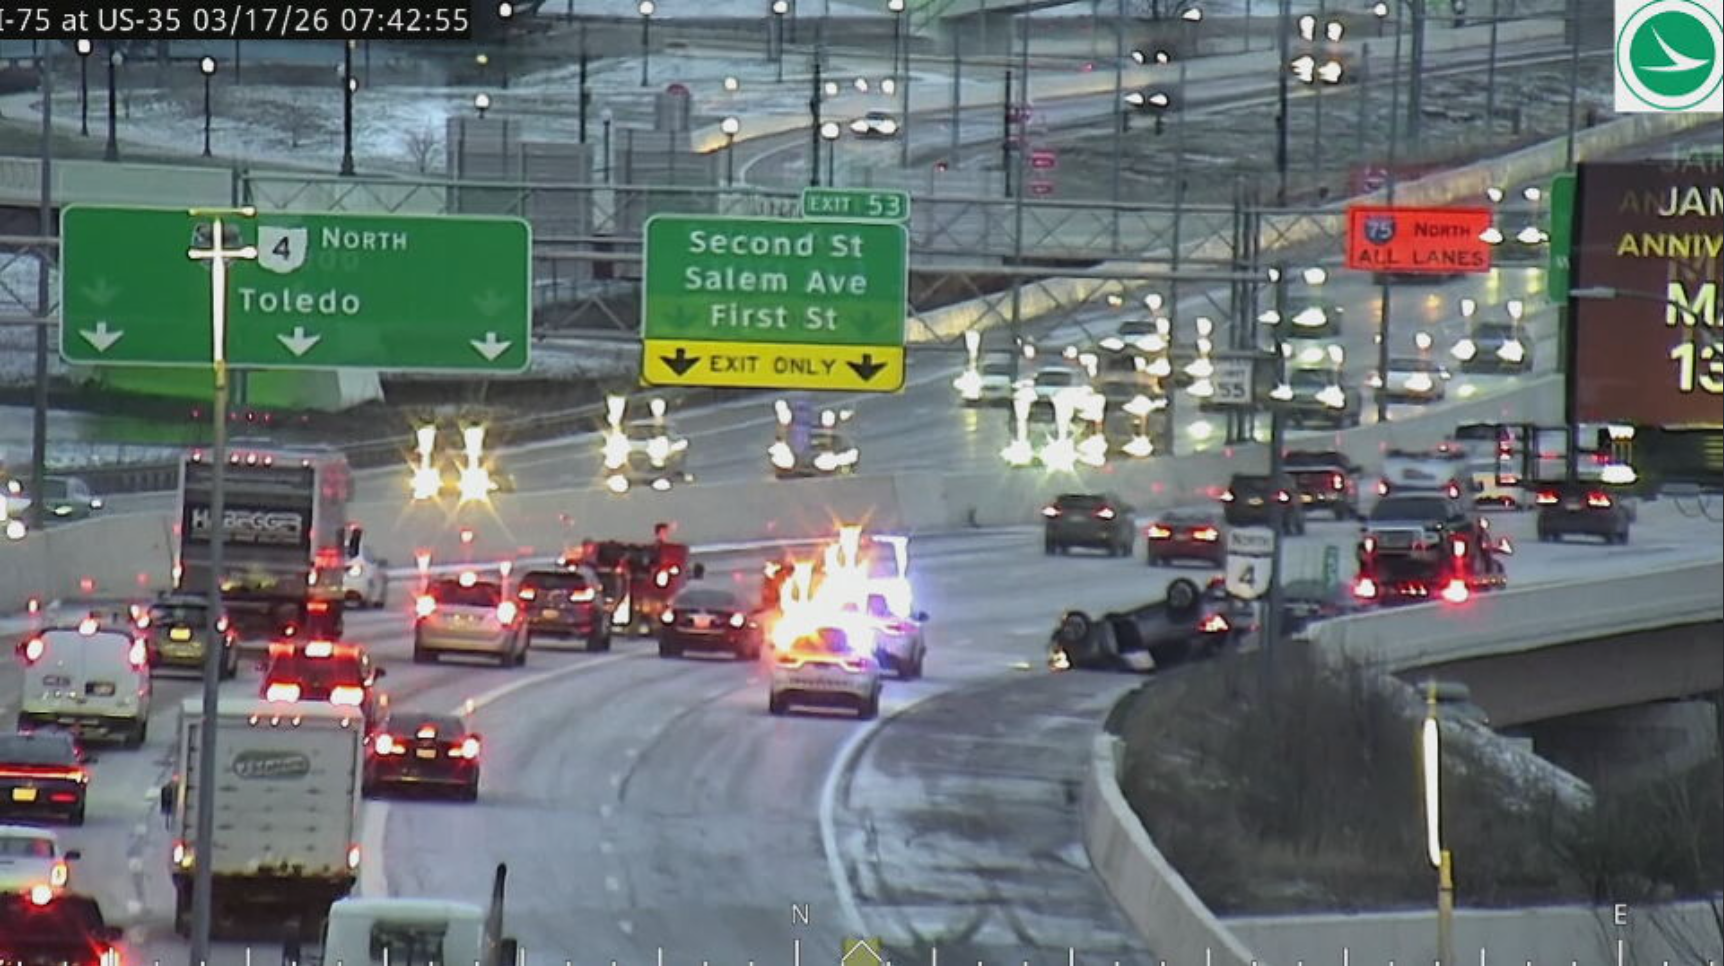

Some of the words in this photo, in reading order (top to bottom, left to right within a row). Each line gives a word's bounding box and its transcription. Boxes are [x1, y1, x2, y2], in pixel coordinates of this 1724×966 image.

[811, 195, 850, 211] EXIT
[867, 194, 901, 216] 53
[1366, 220, 1393, 239] 75
[1414, 222, 1470, 238] NORTH
[272, 236, 290, 260] 4
[322, 227, 407, 249] NORTH
[689, 230, 814, 257] Second
[831, 234, 863, 258] St
[1359, 249, 1398, 264] ALL
[1413, 250, 1483, 266] LANES
[685, 266, 788, 292] Salem
[806, 270, 867, 295] Ave
[238, 287, 360, 314] Toledo
[1666, 282, 1723, 326] M
[711, 302, 787, 328] First
[805, 306, 838, 331] St
[710, 355, 760, 374] EXIT
[773, 356, 836, 375] ONLY
[1218, 382, 1246, 399] 55
[192, 508, 302, 533] HBEGGER
[1238, 565, 1255, 588] 4
